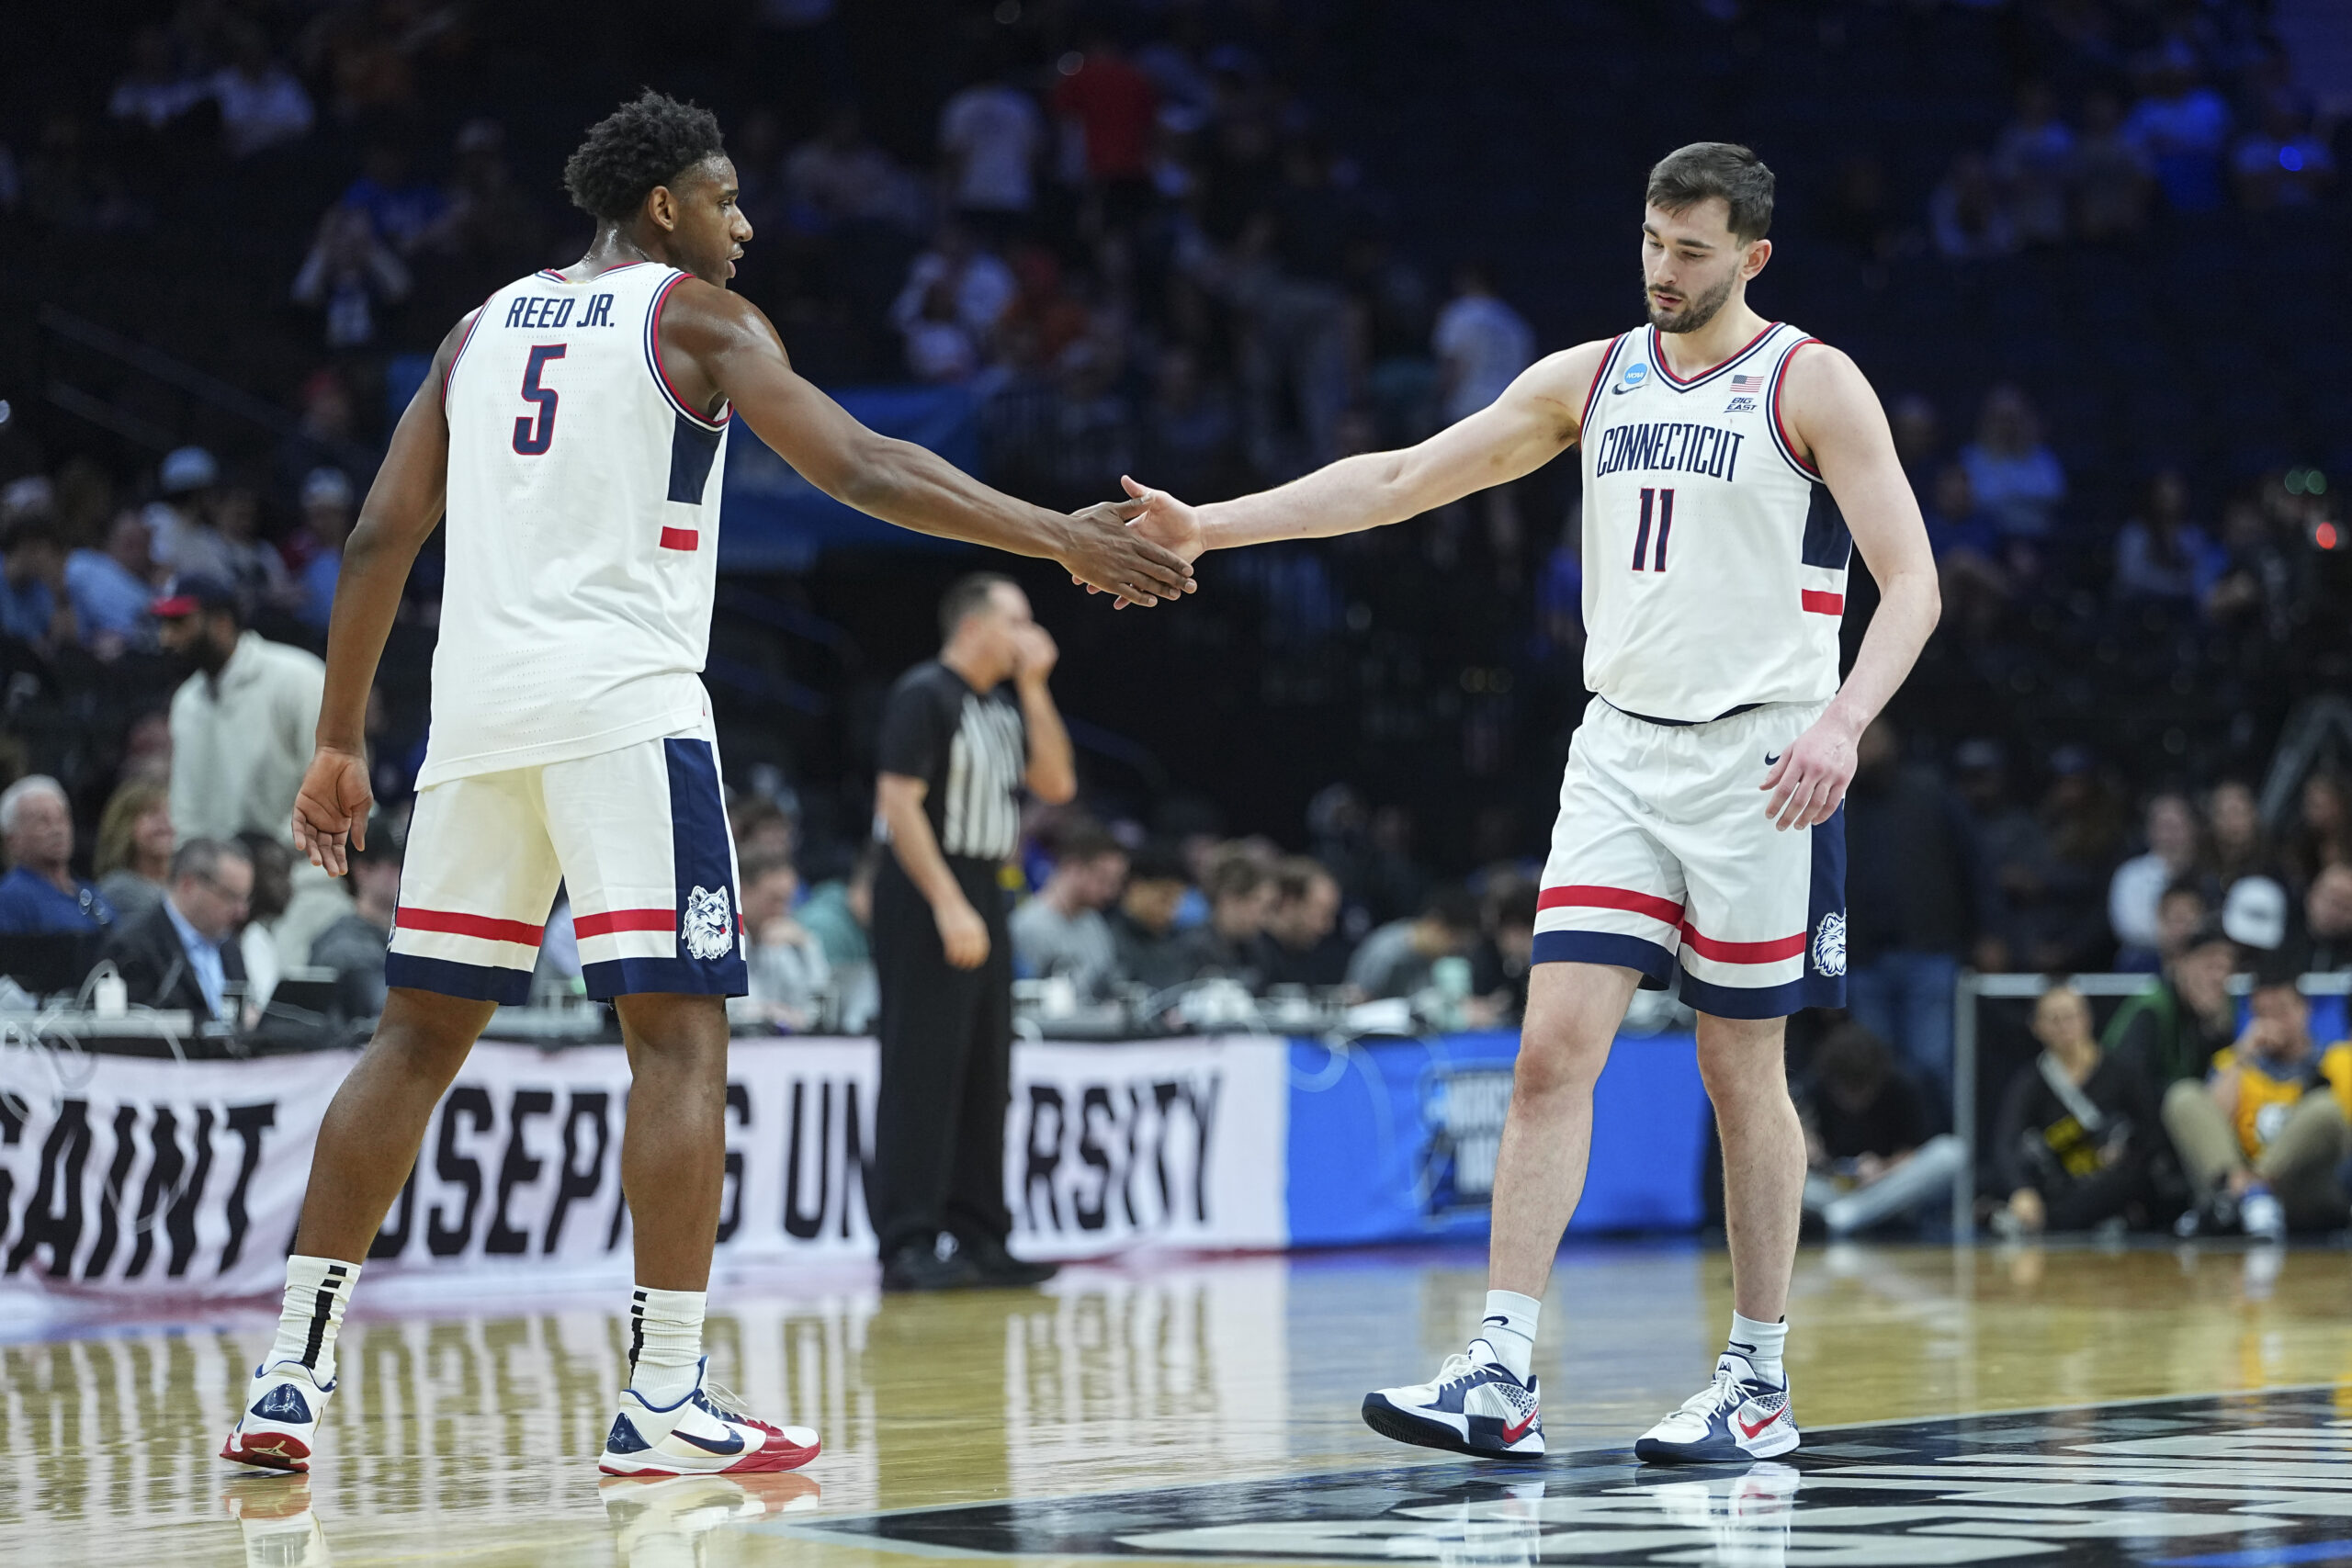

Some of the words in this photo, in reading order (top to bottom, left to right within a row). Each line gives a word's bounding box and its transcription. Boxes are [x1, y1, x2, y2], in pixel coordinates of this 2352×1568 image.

[505, 297, 575, 328] REED
[576, 293, 616, 328] JR.
[512, 343, 567, 456] 5
[1597, 423, 1745, 482] CONNECTICUT
[1632, 488, 1675, 572] 11
